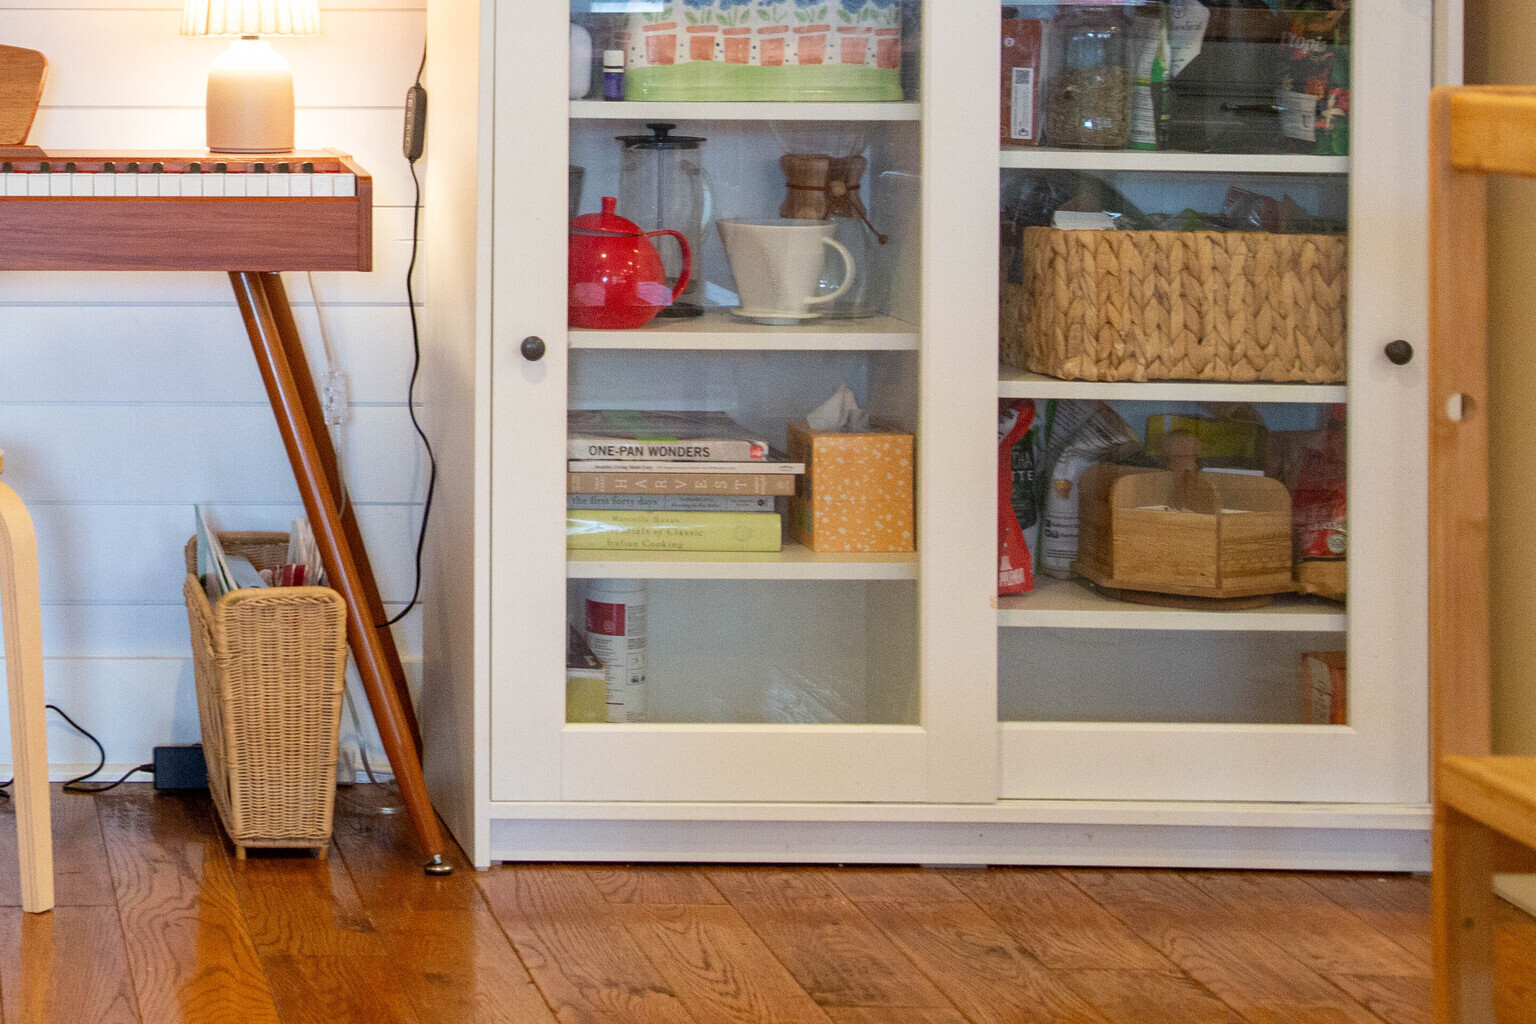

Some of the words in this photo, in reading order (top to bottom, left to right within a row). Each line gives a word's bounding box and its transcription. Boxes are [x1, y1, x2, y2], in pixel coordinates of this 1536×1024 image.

[589, 445, 644, 457] ONE-PAN
[648, 446, 711, 458] WONDERS
[615, 479, 747, 490] HARVEST
[572, 496, 587, 504] the
[590, 496, 609, 505] first
[612, 496, 634, 506] forty
[637, 496, 658, 506] days
[667, 528, 704, 536] Classic
[606, 538, 639, 547] Italian
[642, 540, 684, 549] Cooking
